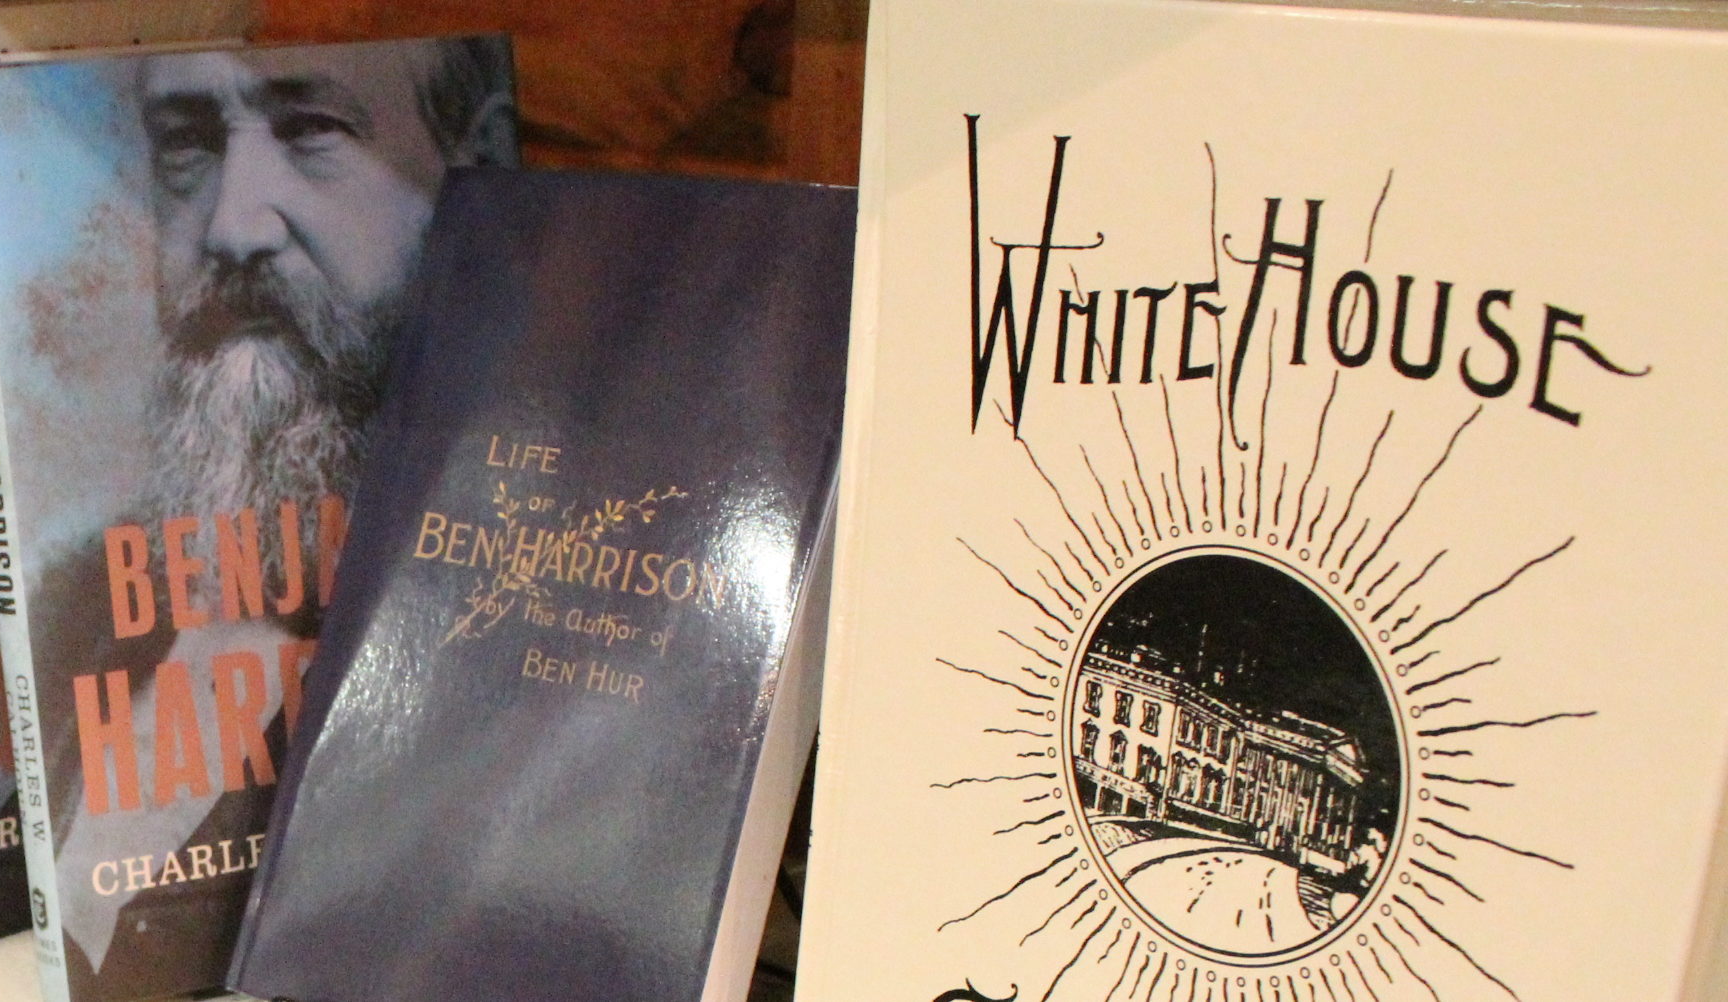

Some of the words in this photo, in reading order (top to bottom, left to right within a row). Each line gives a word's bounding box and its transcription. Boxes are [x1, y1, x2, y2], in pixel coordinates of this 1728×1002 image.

[963, 113, 1226, 441] WHITE
[1222, 196, 1652, 452] HOUSE
[485, 434, 562, 474] LIFE
[413, 510, 501, 570] BEN
[511, 525, 727, 610] HARRISON
[521, 647, 577, 685] BEN
[587, 663, 645, 703] HUR
[15, 674, 42, 809] CHARLES
